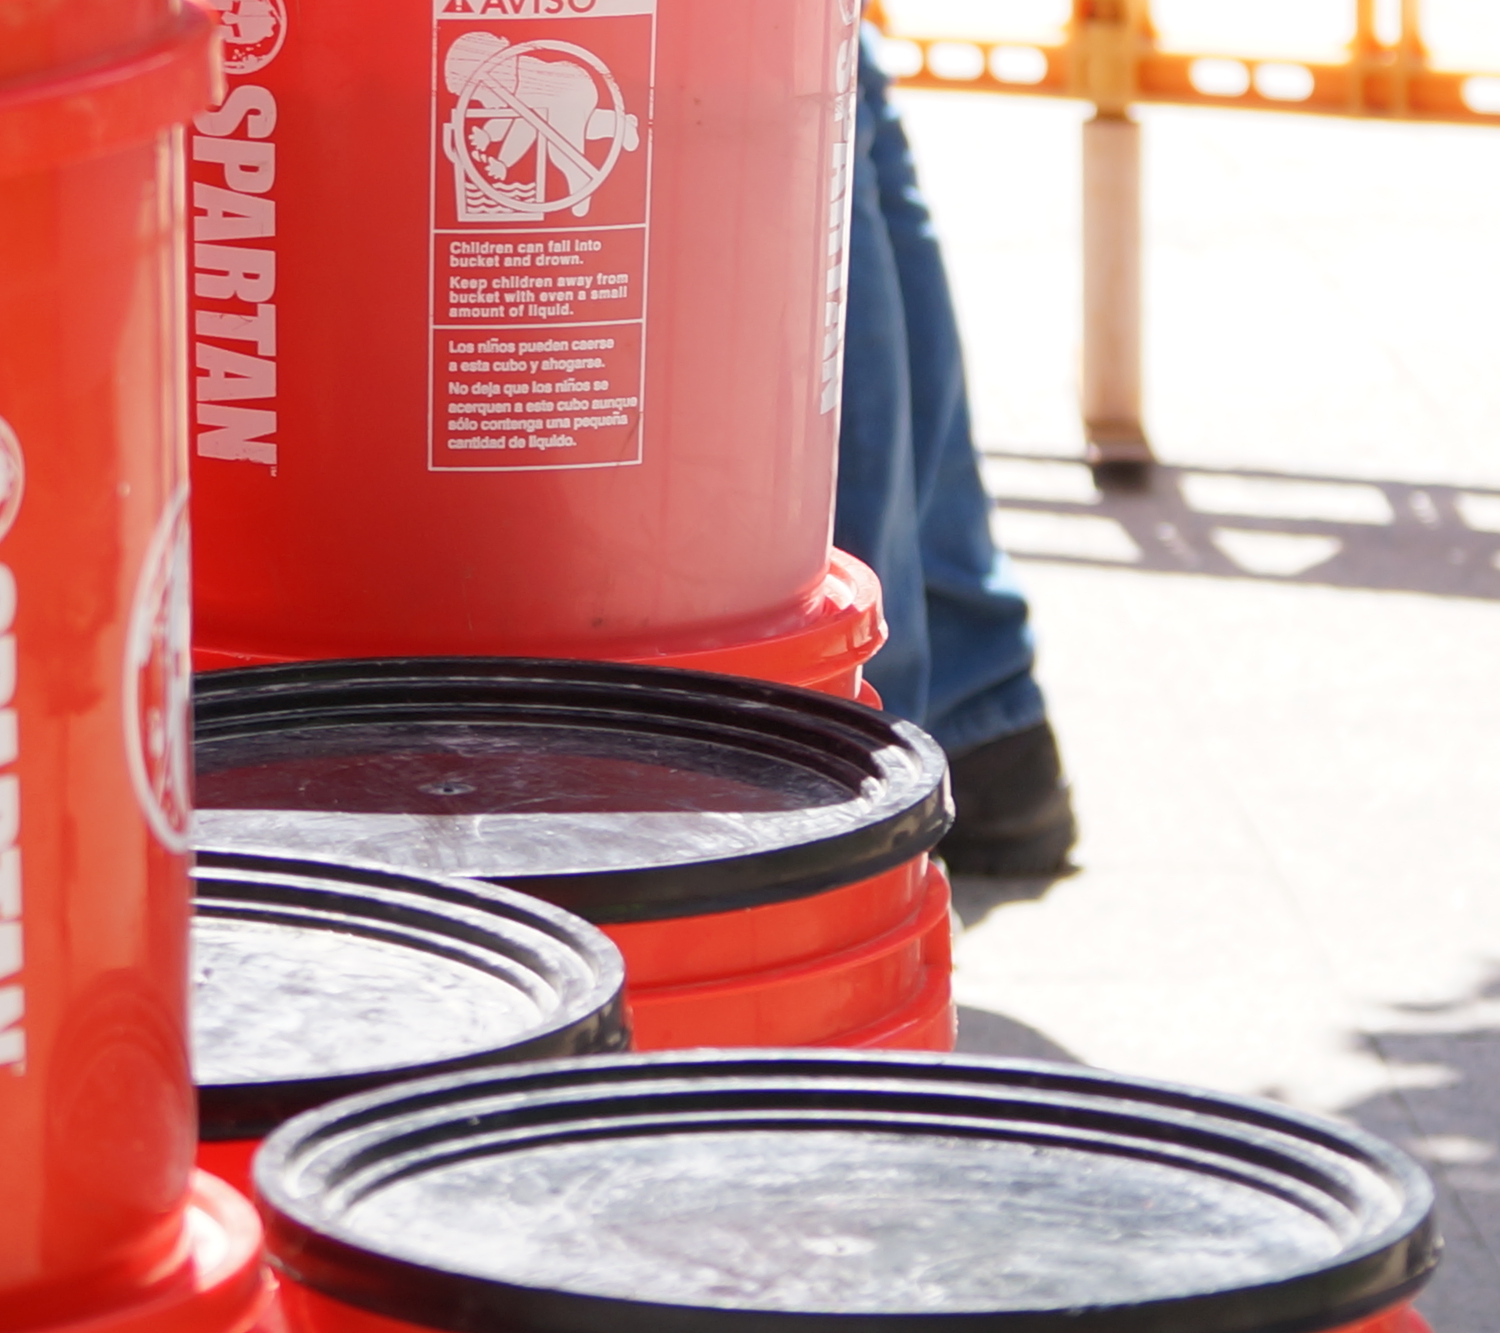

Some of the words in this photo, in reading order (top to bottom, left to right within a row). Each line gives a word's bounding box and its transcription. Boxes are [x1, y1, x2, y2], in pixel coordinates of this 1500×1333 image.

[450, 242, 513, 254] Children
[518, 243, 543, 252] can
[548, 241, 571, 252] fall
[575, 239, 601, 251] into
[450, 255, 500, 267] bucket
[504, 255, 531, 266] and
[535, 254, 584, 266] drown.
[191, 84, 278, 465] SPARTAN
[450, 277, 487, 292] Keep
[492, 276, 552, 288] children
[557, 275, 592, 288] away
[597, 272, 628, 284] from
[450, 290, 500, 303] bucket
[504, 290, 534, 302] with
[539, 290, 574, 301] even
[578, 290, 586, 300] a
[591, 286, 627, 299] small
[449, 305, 505, 317] amount
[509, 305, 524, 316] of
[529, 303, 574, 319] liquid.
[449, 341, 474, 353] Los
[478, 338, 515, 353] niños
[519, 339, 568, 355] pueden
[572, 338, 614, 350] caerse
[449, 361, 457, 371] a
[493, 358, 527, 370] cubo
[530, 359, 538, 373] y
[541, 357, 605, 372] ahogarse.
[449, 382, 468, 395] No
[504, 383, 528, 397] que
[532, 380, 552, 393] los
[555, 378, 590, 393] niños
[593, 380, 609, 391] se
[448, 401, 511, 415] acerquen
[514, 402, 522, 412] a
[557, 398, 588, 411] cubo
[592, 396, 637, 411] aunque
[448, 418, 477, 431] sólo
[481, 419, 543, 432] contenga
[546, 418, 571, 429] una
[574, 411, 628, 430] pequeña
[448, 436, 505, 449] cantidad
[509, 436, 526, 448] de
